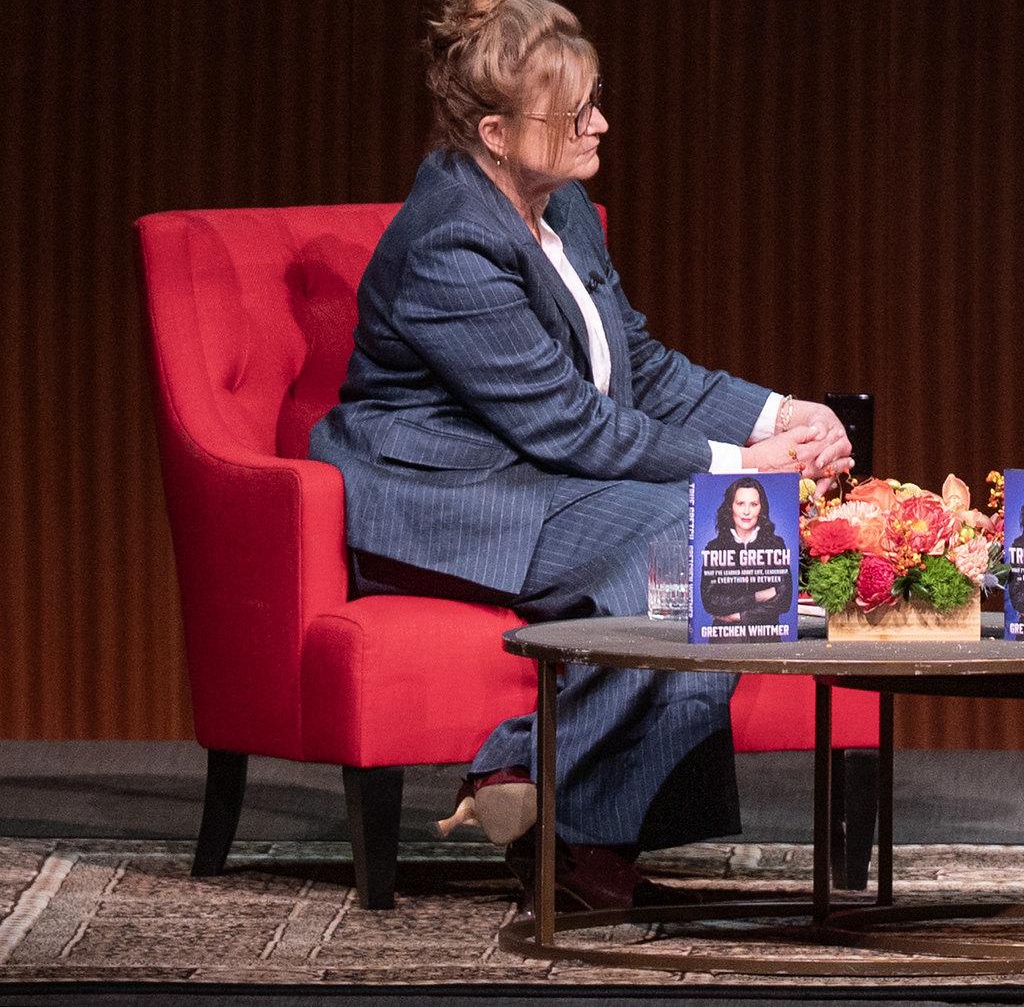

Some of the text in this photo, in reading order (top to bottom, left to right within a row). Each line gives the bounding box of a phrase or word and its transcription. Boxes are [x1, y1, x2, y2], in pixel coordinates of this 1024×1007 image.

[701, 548, 791, 567] TRUE GRETCH
[701, 624, 790, 638] GRETCHEN WHITMER
